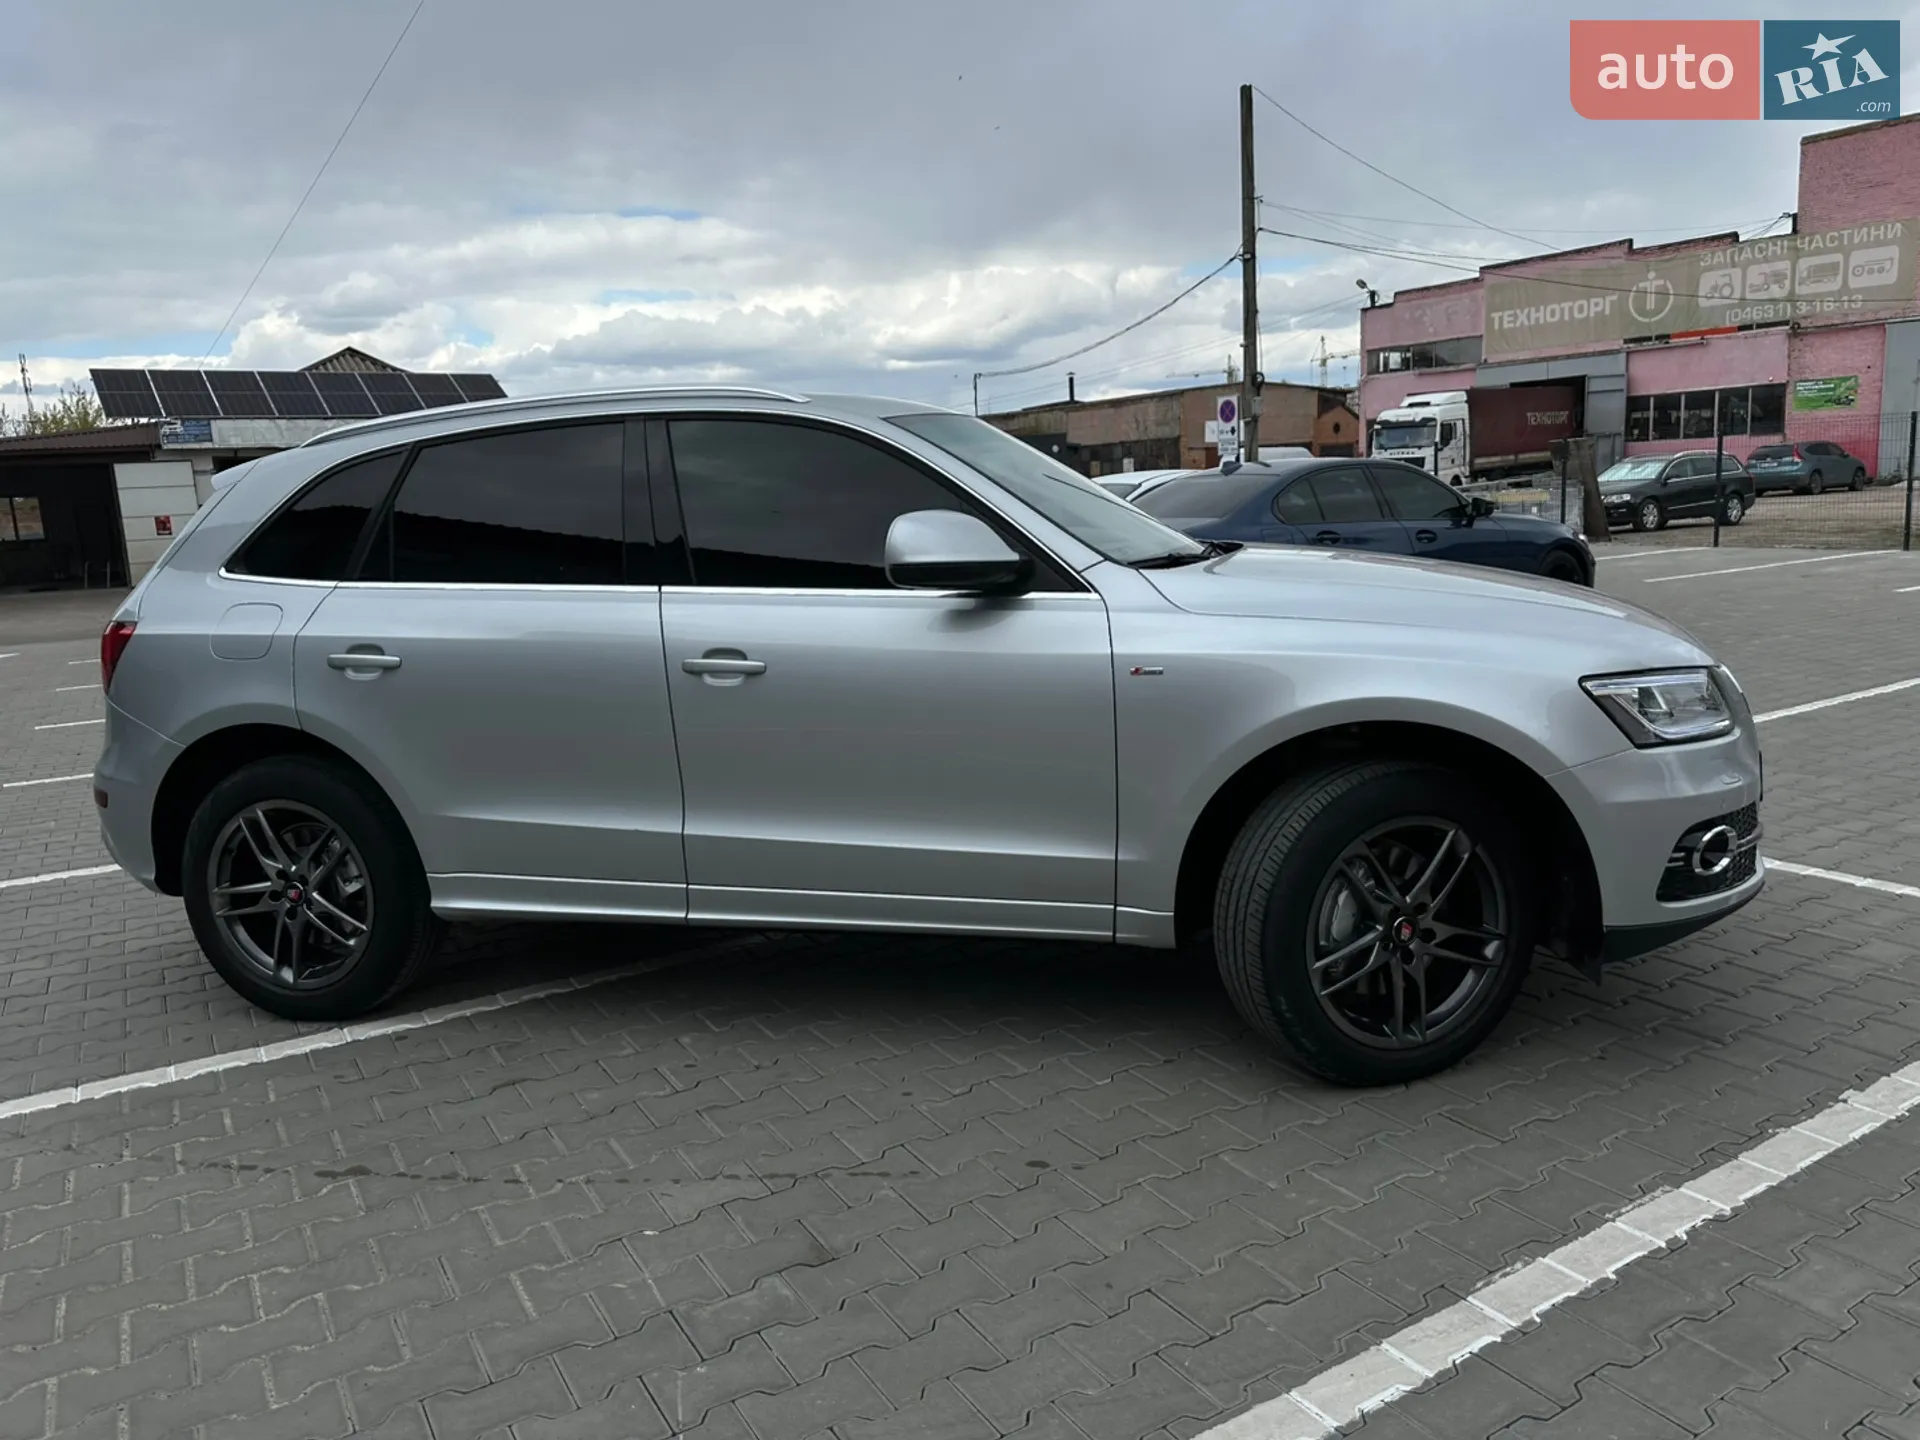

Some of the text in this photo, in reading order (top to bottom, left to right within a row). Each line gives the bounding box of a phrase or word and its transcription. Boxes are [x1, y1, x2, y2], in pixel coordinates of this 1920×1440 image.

[1699, 222, 1905, 267] ЗАПАСНІ ЧАСТИНИ
[1490, 291, 1620, 331] ТЕХНОТОРГ
[1725, 301, 1792, 326] (04631)
